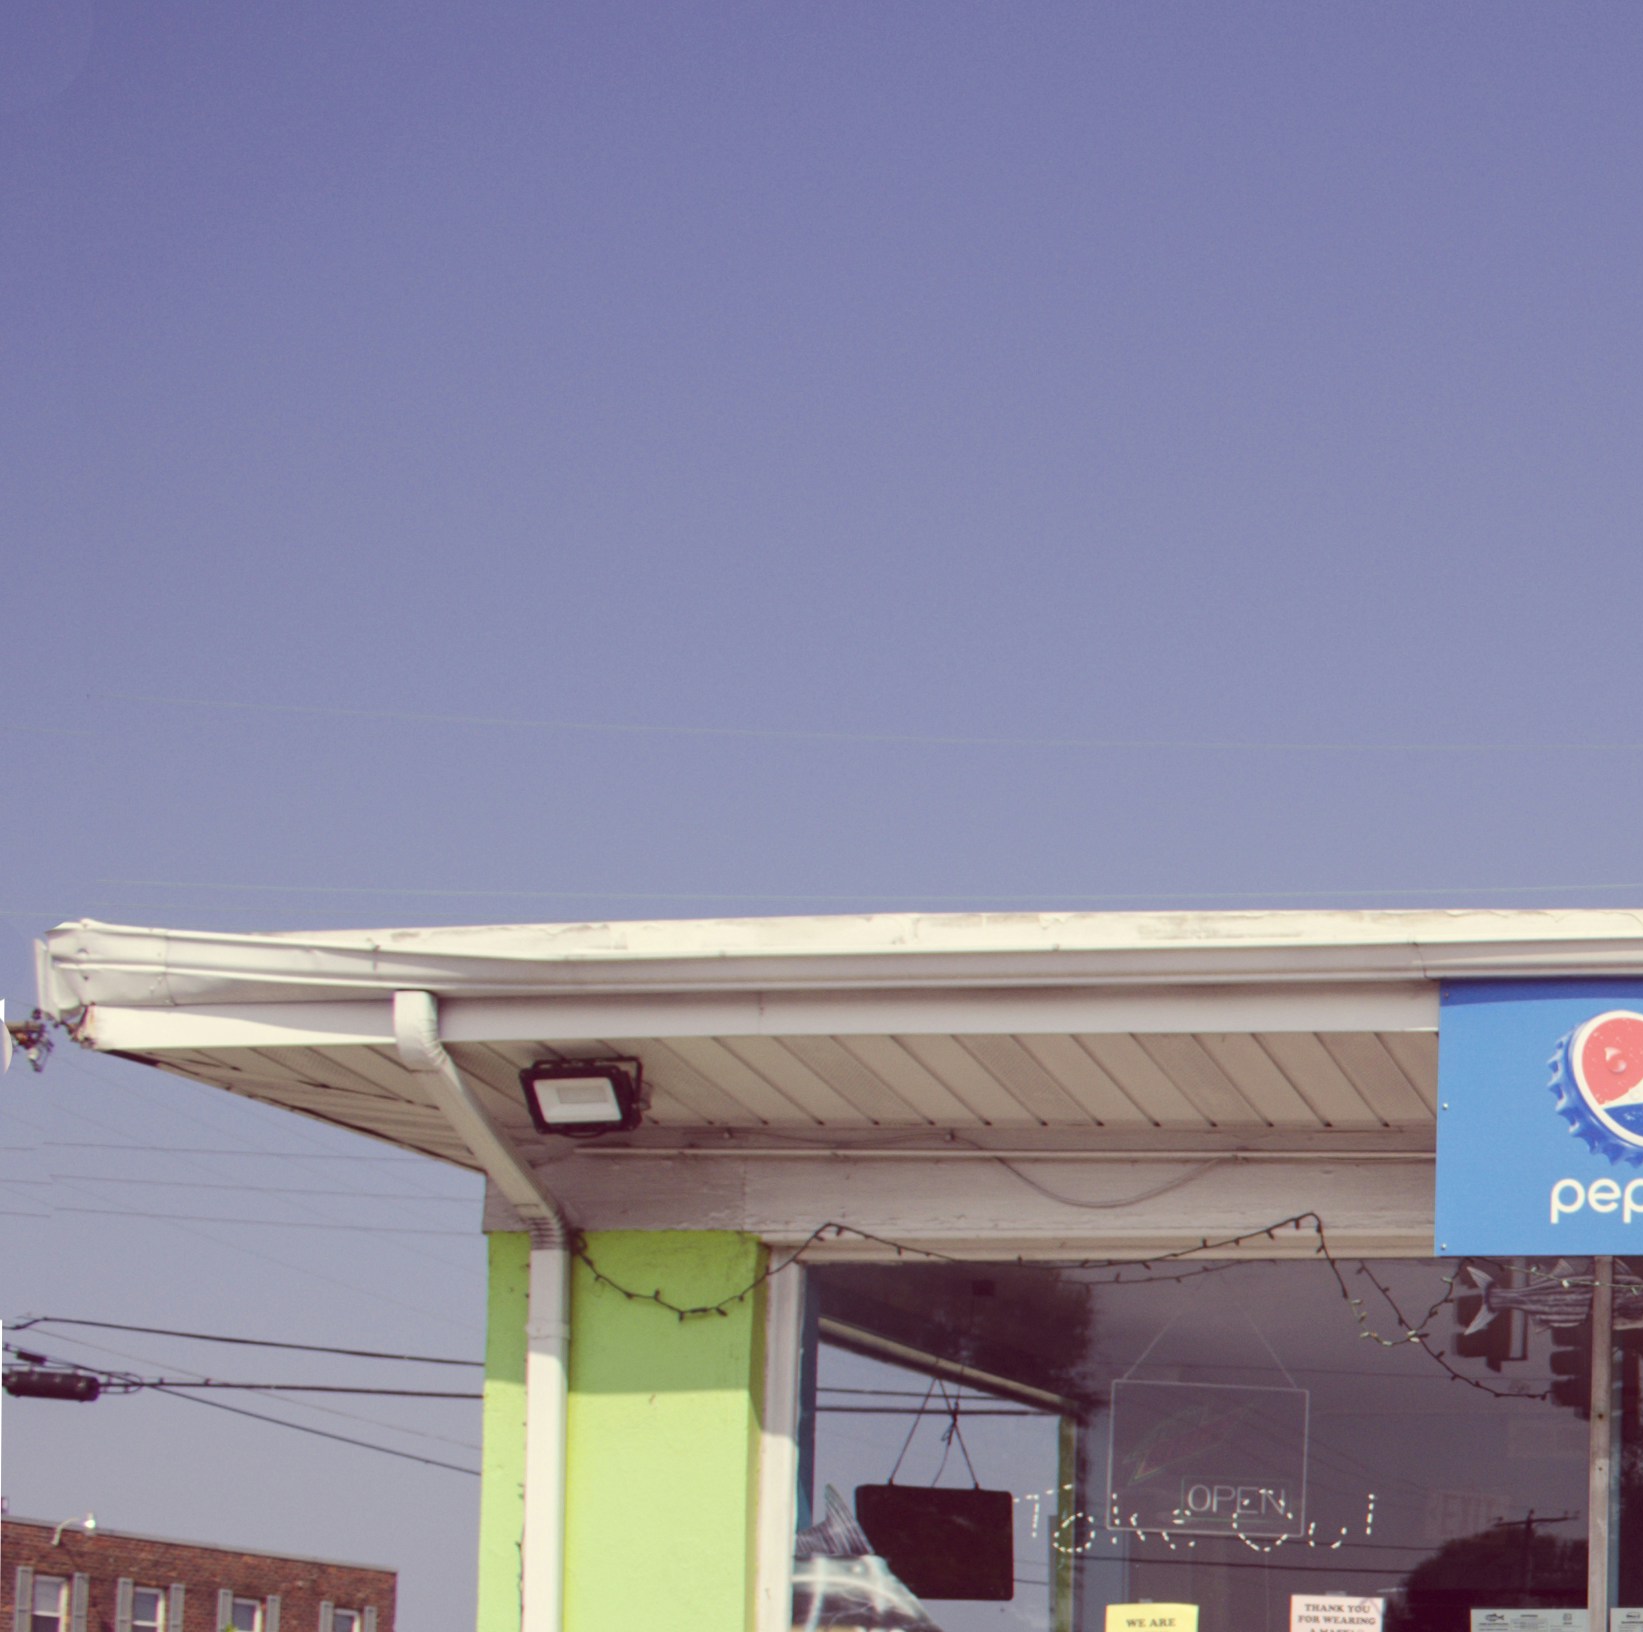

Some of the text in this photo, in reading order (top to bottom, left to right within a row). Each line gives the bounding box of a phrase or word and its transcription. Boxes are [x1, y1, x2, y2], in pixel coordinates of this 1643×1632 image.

[1187, 1483, 1287, 1515] OPEN
[1305, 1604, 1370, 1613] THANK YOU
[1126, 1618, 1176, 1628] WE ARE
[1298, 1615, 1376, 1625] FOR WEARING
